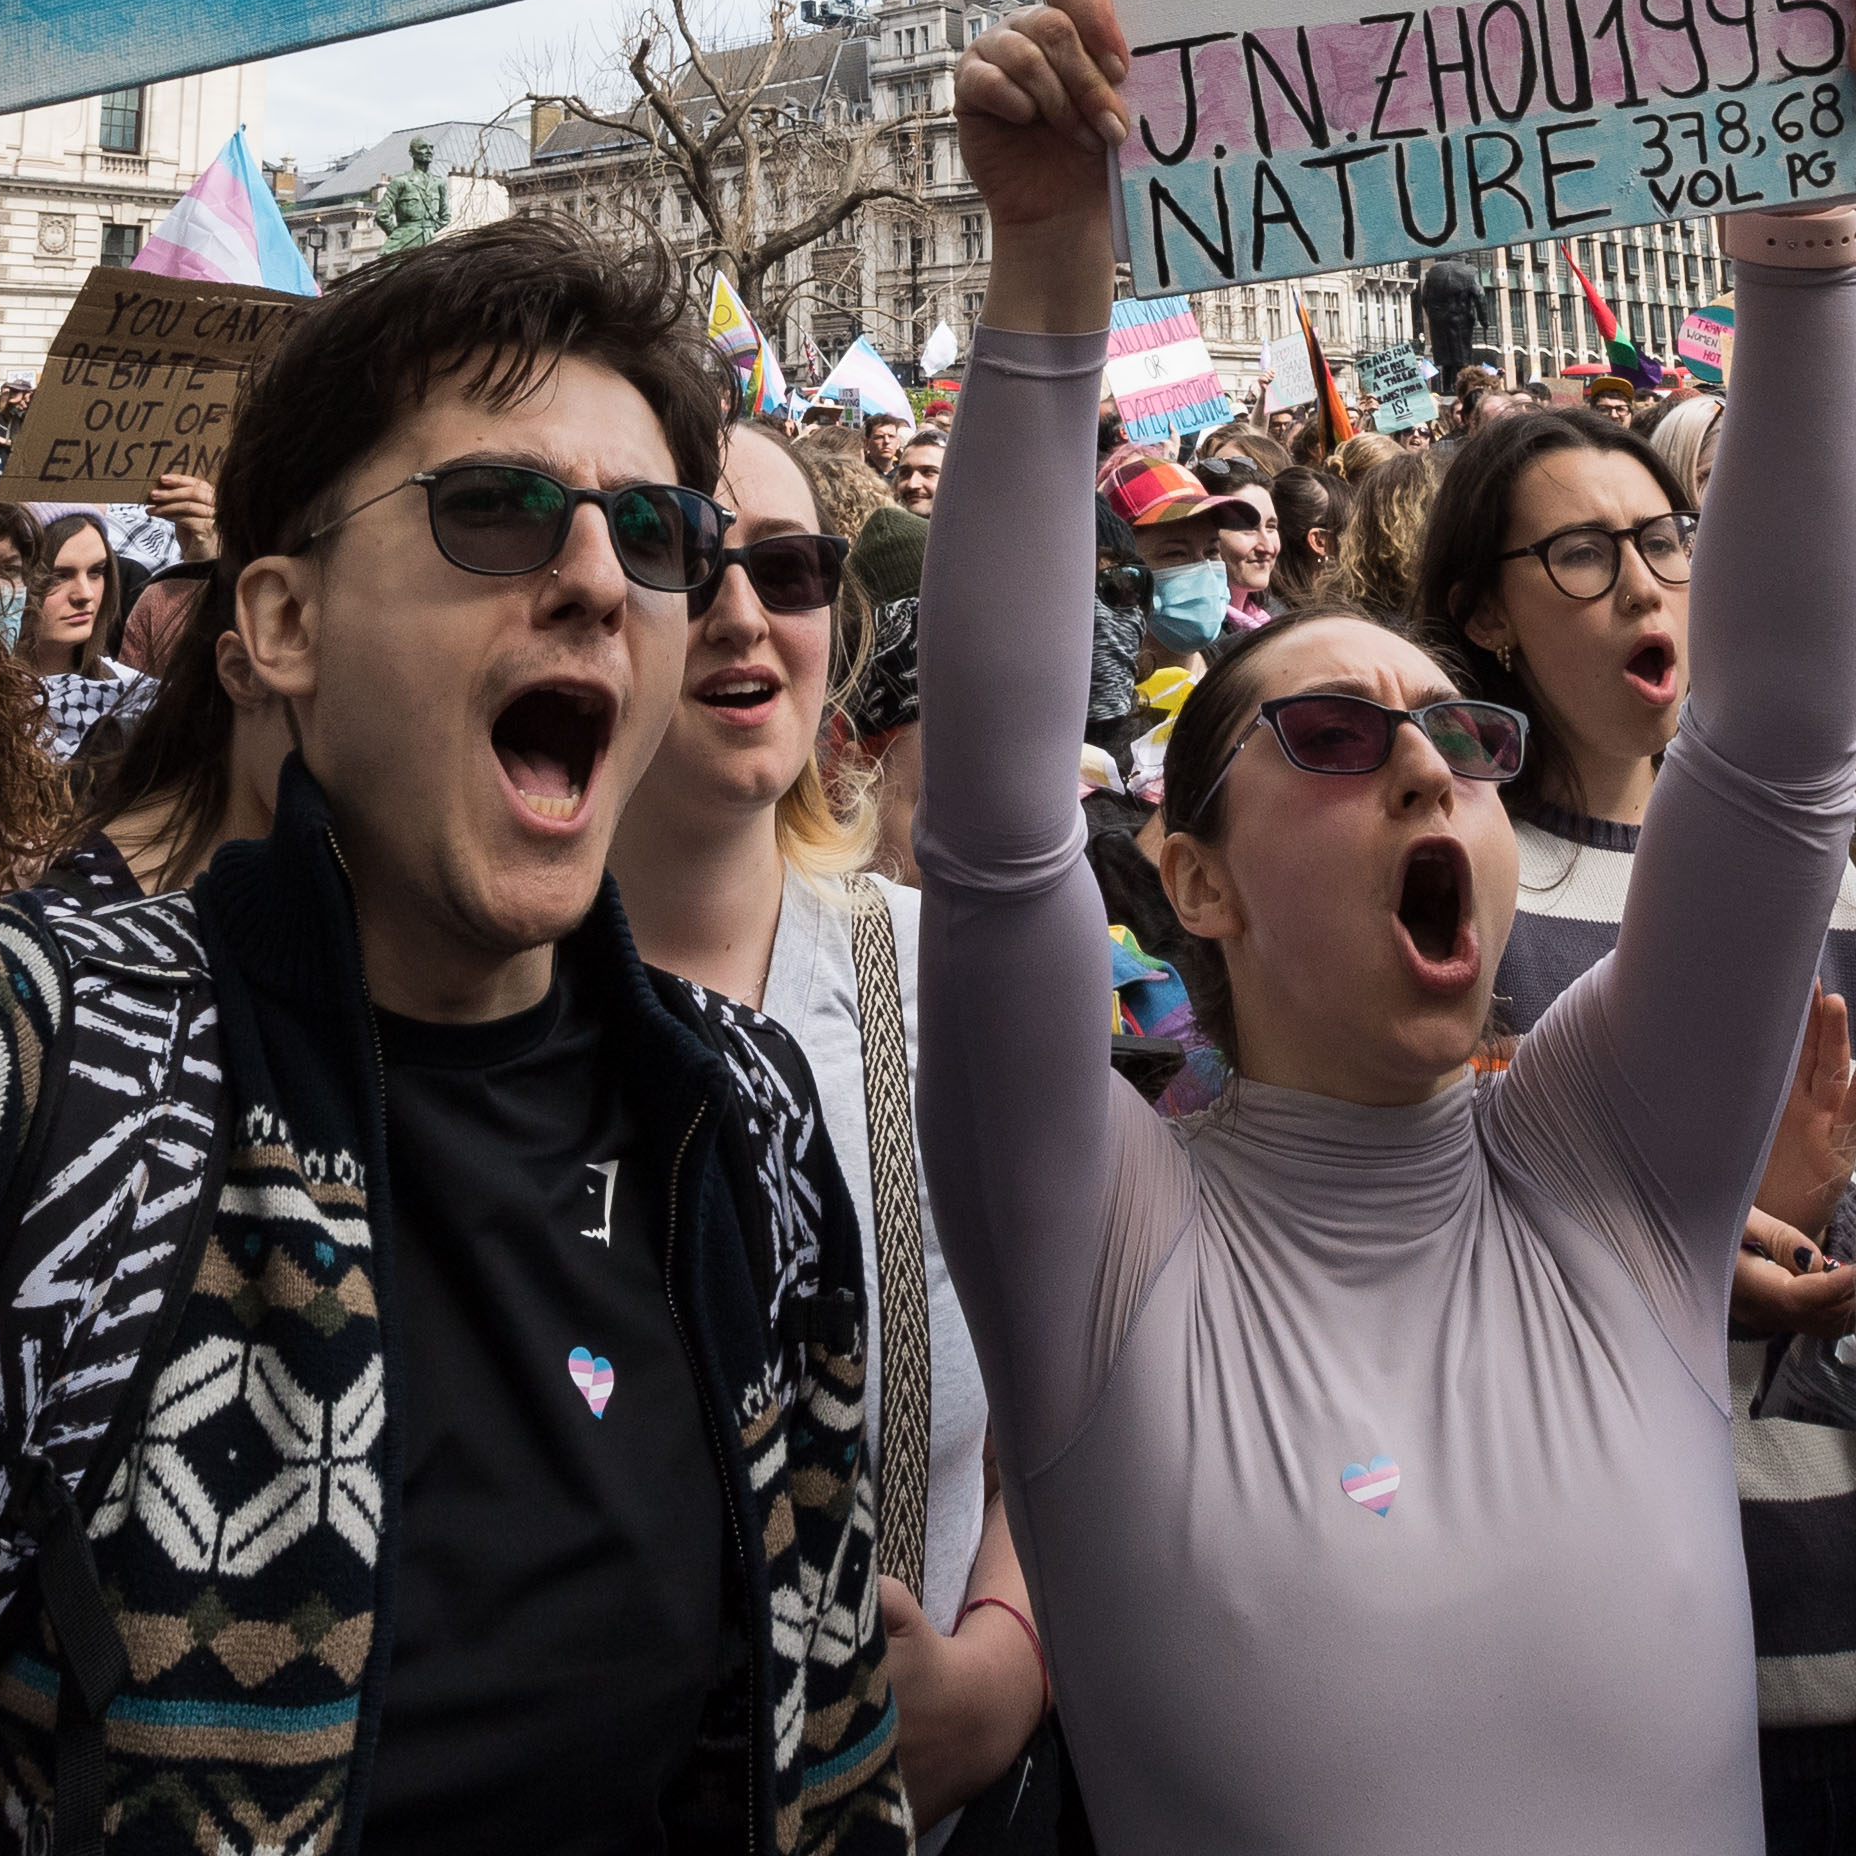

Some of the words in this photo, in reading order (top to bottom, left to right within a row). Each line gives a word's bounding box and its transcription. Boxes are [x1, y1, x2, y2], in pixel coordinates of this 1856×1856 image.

[1648, 170, 1765, 211] VOL
[1786, 148, 1838, 199] PG
[1149, 119, 1613, 289] NATURE
[105, 291, 186, 339] YOU
[1687, 328, 1719, 349] WOMEN
[62, 345, 215, 391] DEBATE
[1144, 354, 1168, 379] OR
[1358, 350, 1392, 373] TRANS
[1703, 349, 1722, 364] HOT
[1374, 364, 1390, 380] ARE
[1373, 381, 1381, 392] A
[85, 399, 164, 433] OUT
[174, 402, 228, 435] OF
[1391, 398, 1410, 416] IS!
[39, 440, 226, 483] EXISTAN
